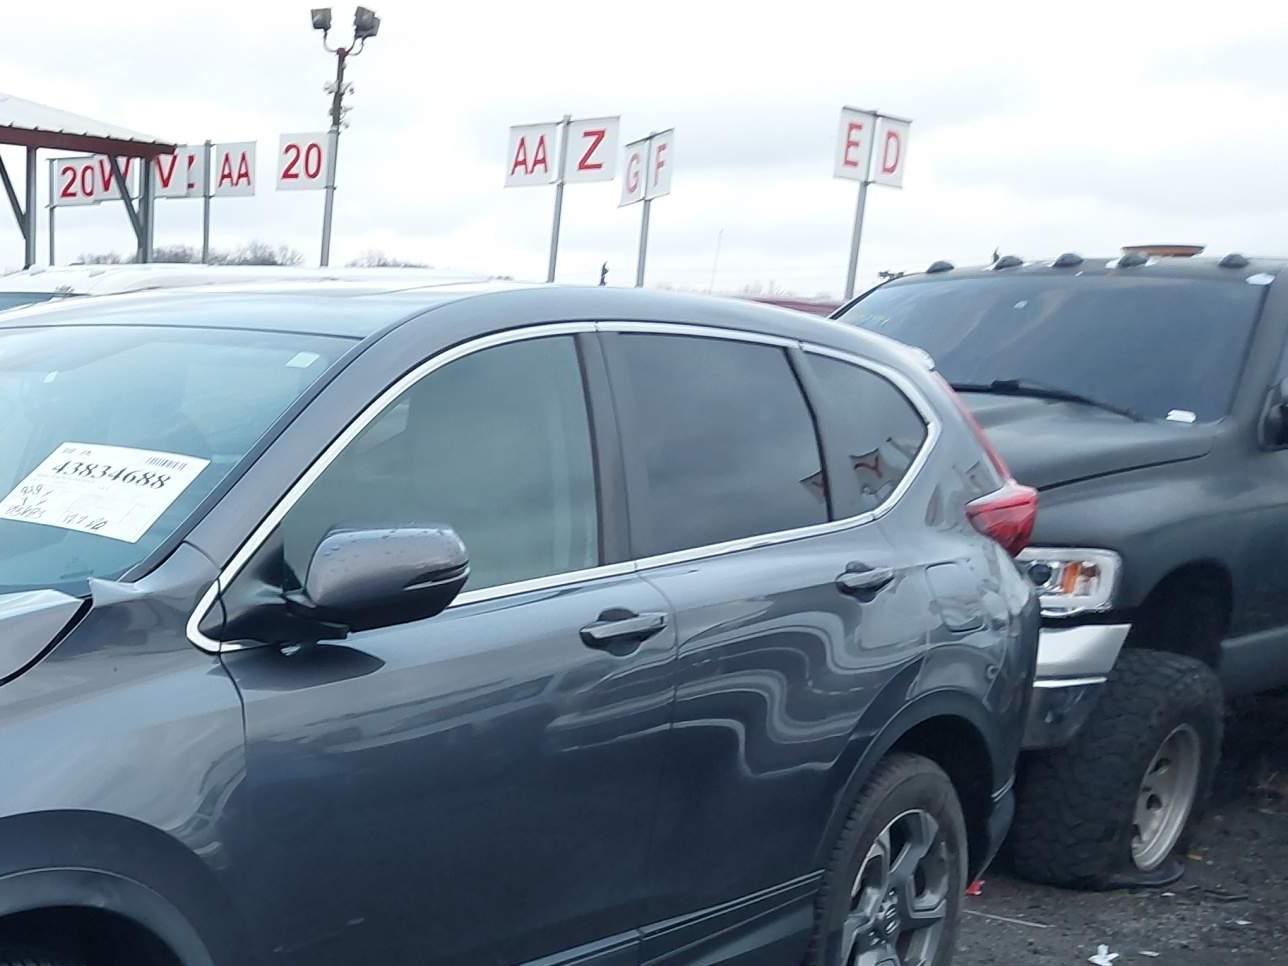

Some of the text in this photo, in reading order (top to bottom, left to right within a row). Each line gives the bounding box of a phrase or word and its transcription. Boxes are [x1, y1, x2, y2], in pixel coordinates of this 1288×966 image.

[280, 143, 323, 181] 20
[511, 135, 549, 175] AA
[577, 129, 607, 171] Z
[842, 122, 863, 167] E
[880, 131, 901, 175] D
[59, 164, 95, 198] 20
[219, 152, 252, 187] AA
[626, 152, 641, 193] G
[653, 143, 667, 187] F
[52, 460, 171, 489] 43834688
